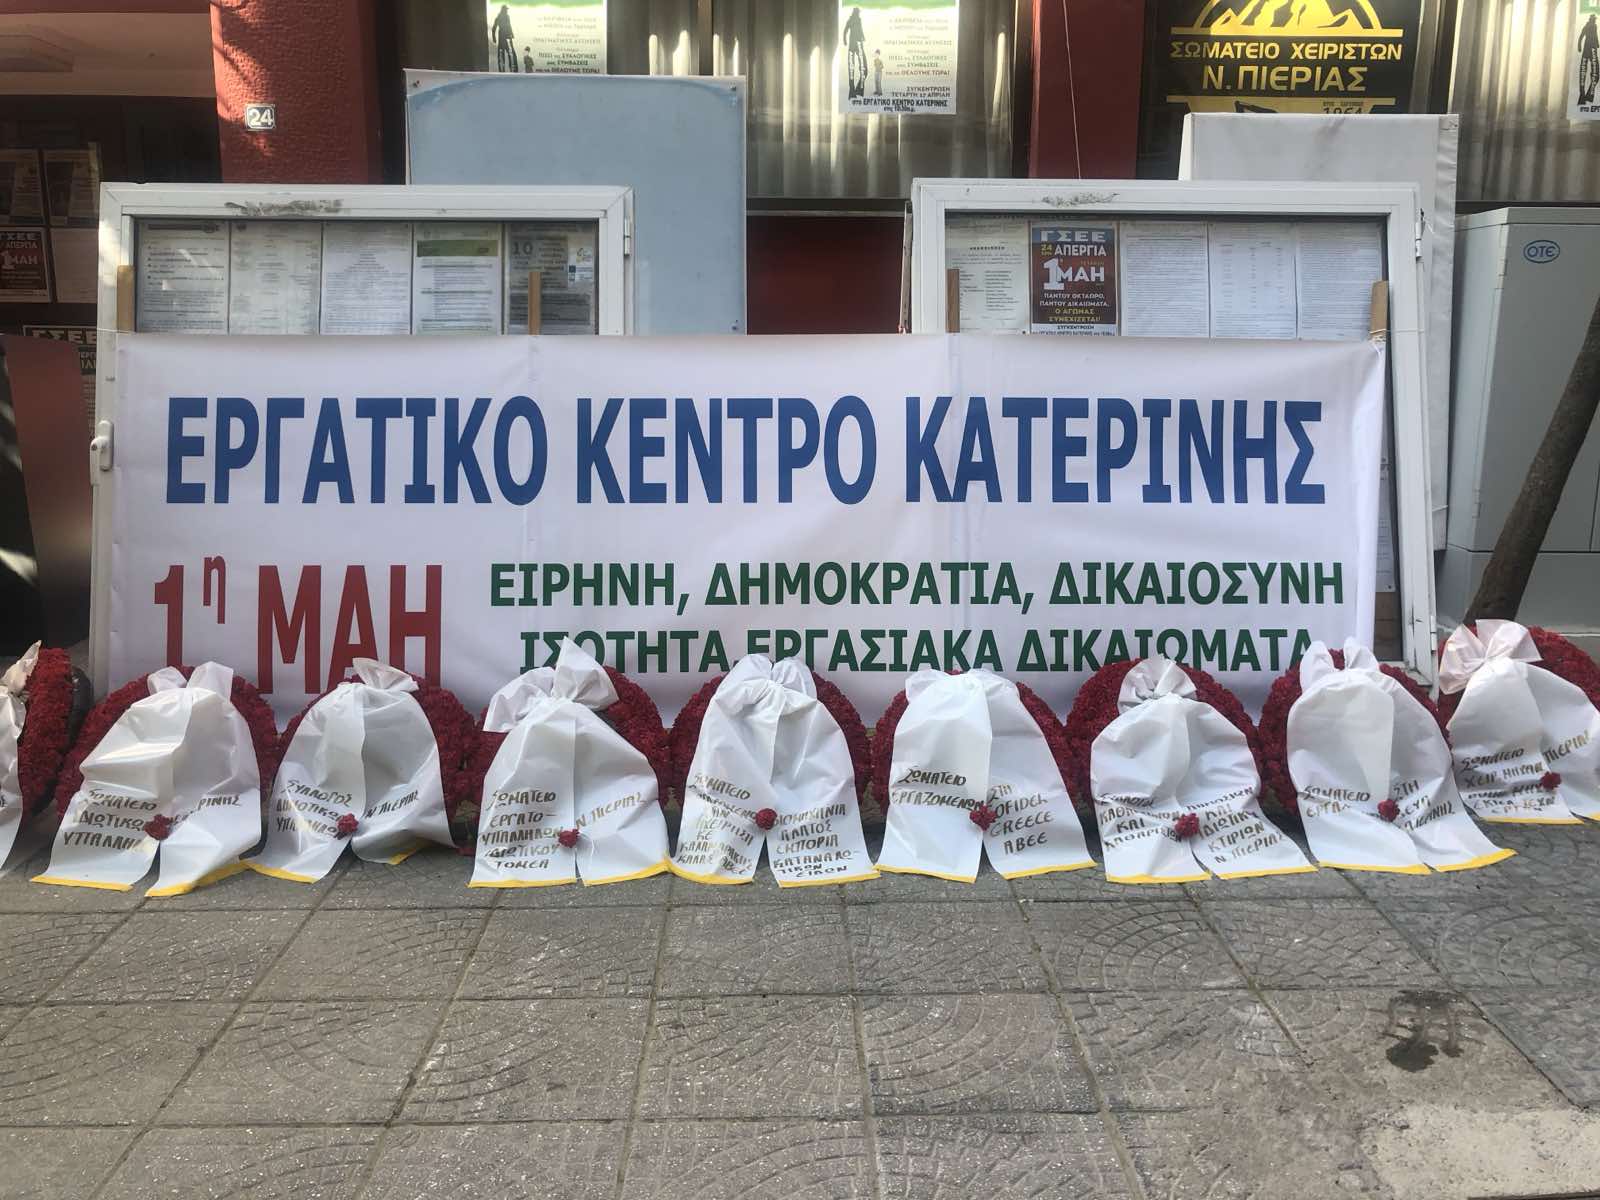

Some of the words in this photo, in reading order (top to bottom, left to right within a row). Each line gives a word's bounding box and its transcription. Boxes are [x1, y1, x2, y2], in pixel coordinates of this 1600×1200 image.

[1170, 41, 1280, 60] ΣΩΜΑΤΕΙΟ
[1291, 42, 1402, 60] ΧΕΙΡΙΣΤΩΝ
[1203, 65, 1231, 90] Ν.
[1238, 66, 1367, 92] ΠΙΕΡΙΑΣ
[249, 108, 274, 126] 24
[1040, 230, 1106, 242] ΓΣΕΕ
[1054, 244, 1107, 257] ΑΠΕΡΓΙΑ
[1057, 266, 1105, 282] ΜΑΗ
[166, 395, 548, 506] ΕΡΓΑΤΙΚΟ
[577, 395, 877, 505] ΚΕΝΤΡΟ
[906, 396, 1325, 504] ΚΑΤΕΡΙΝΗΣ
[491, 562, 690, 616] ΕΙΡΗΝΗ,
[704, 562, 1034, 615] ΔΗΜΟΚΡΑΤΙΑ,
[1049, 562, 1344, 604] ΔΙΚΑΙΟΣΥΝΗ
[154, 555, 226, 673] 1η
[257, 564, 443, 694] ΜΑΗ
[747, 629, 1003, 672] ΕΡΓΑΣΙΑΚΑ
[1016, 628, 1311, 672] ΔΙΚΑΙΩΜΑΤΑ
[897, 767, 967, 787] ΣΩΜΑΤΕΙΟ
[1116, 817, 1146, 834] ΚΑΙ
